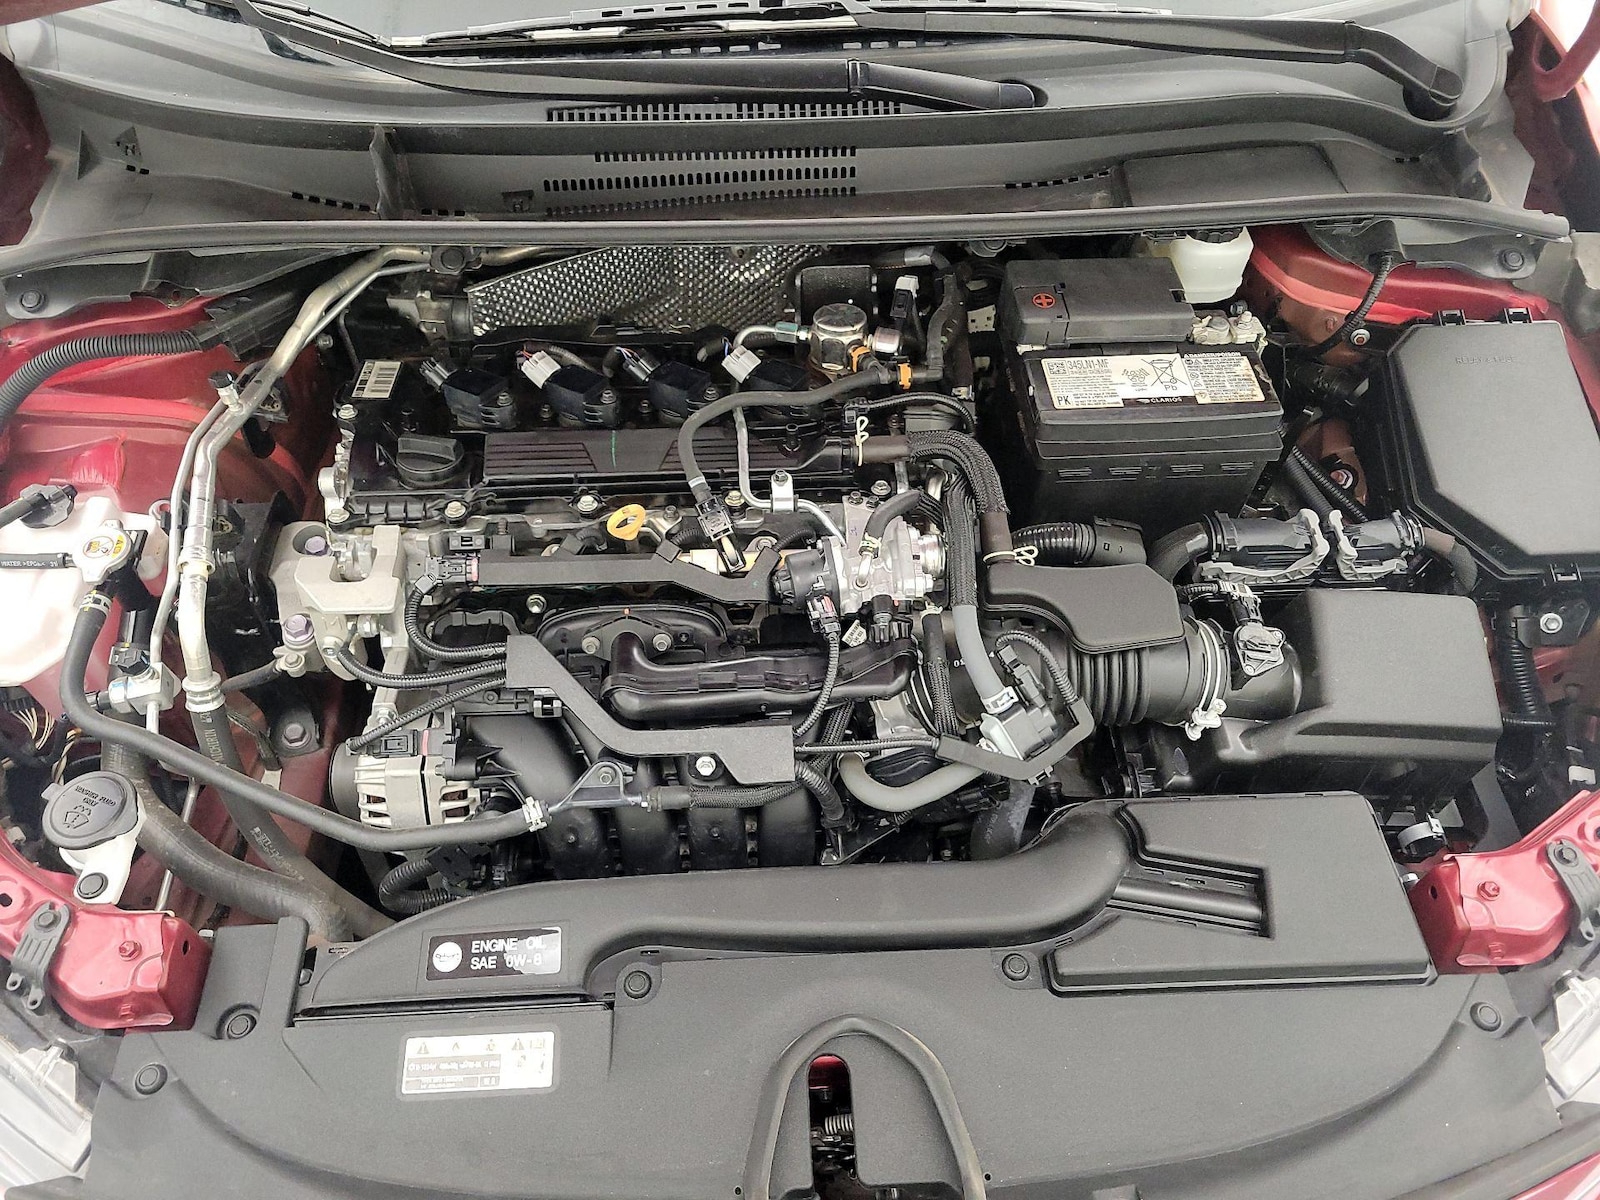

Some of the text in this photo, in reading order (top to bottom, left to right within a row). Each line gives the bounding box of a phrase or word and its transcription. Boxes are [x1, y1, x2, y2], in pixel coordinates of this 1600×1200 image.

[1056, 395, 1071, 405] PK
[471, 936, 547, 954] ENGINE OIL
[470, 956, 498, 970] SAE
